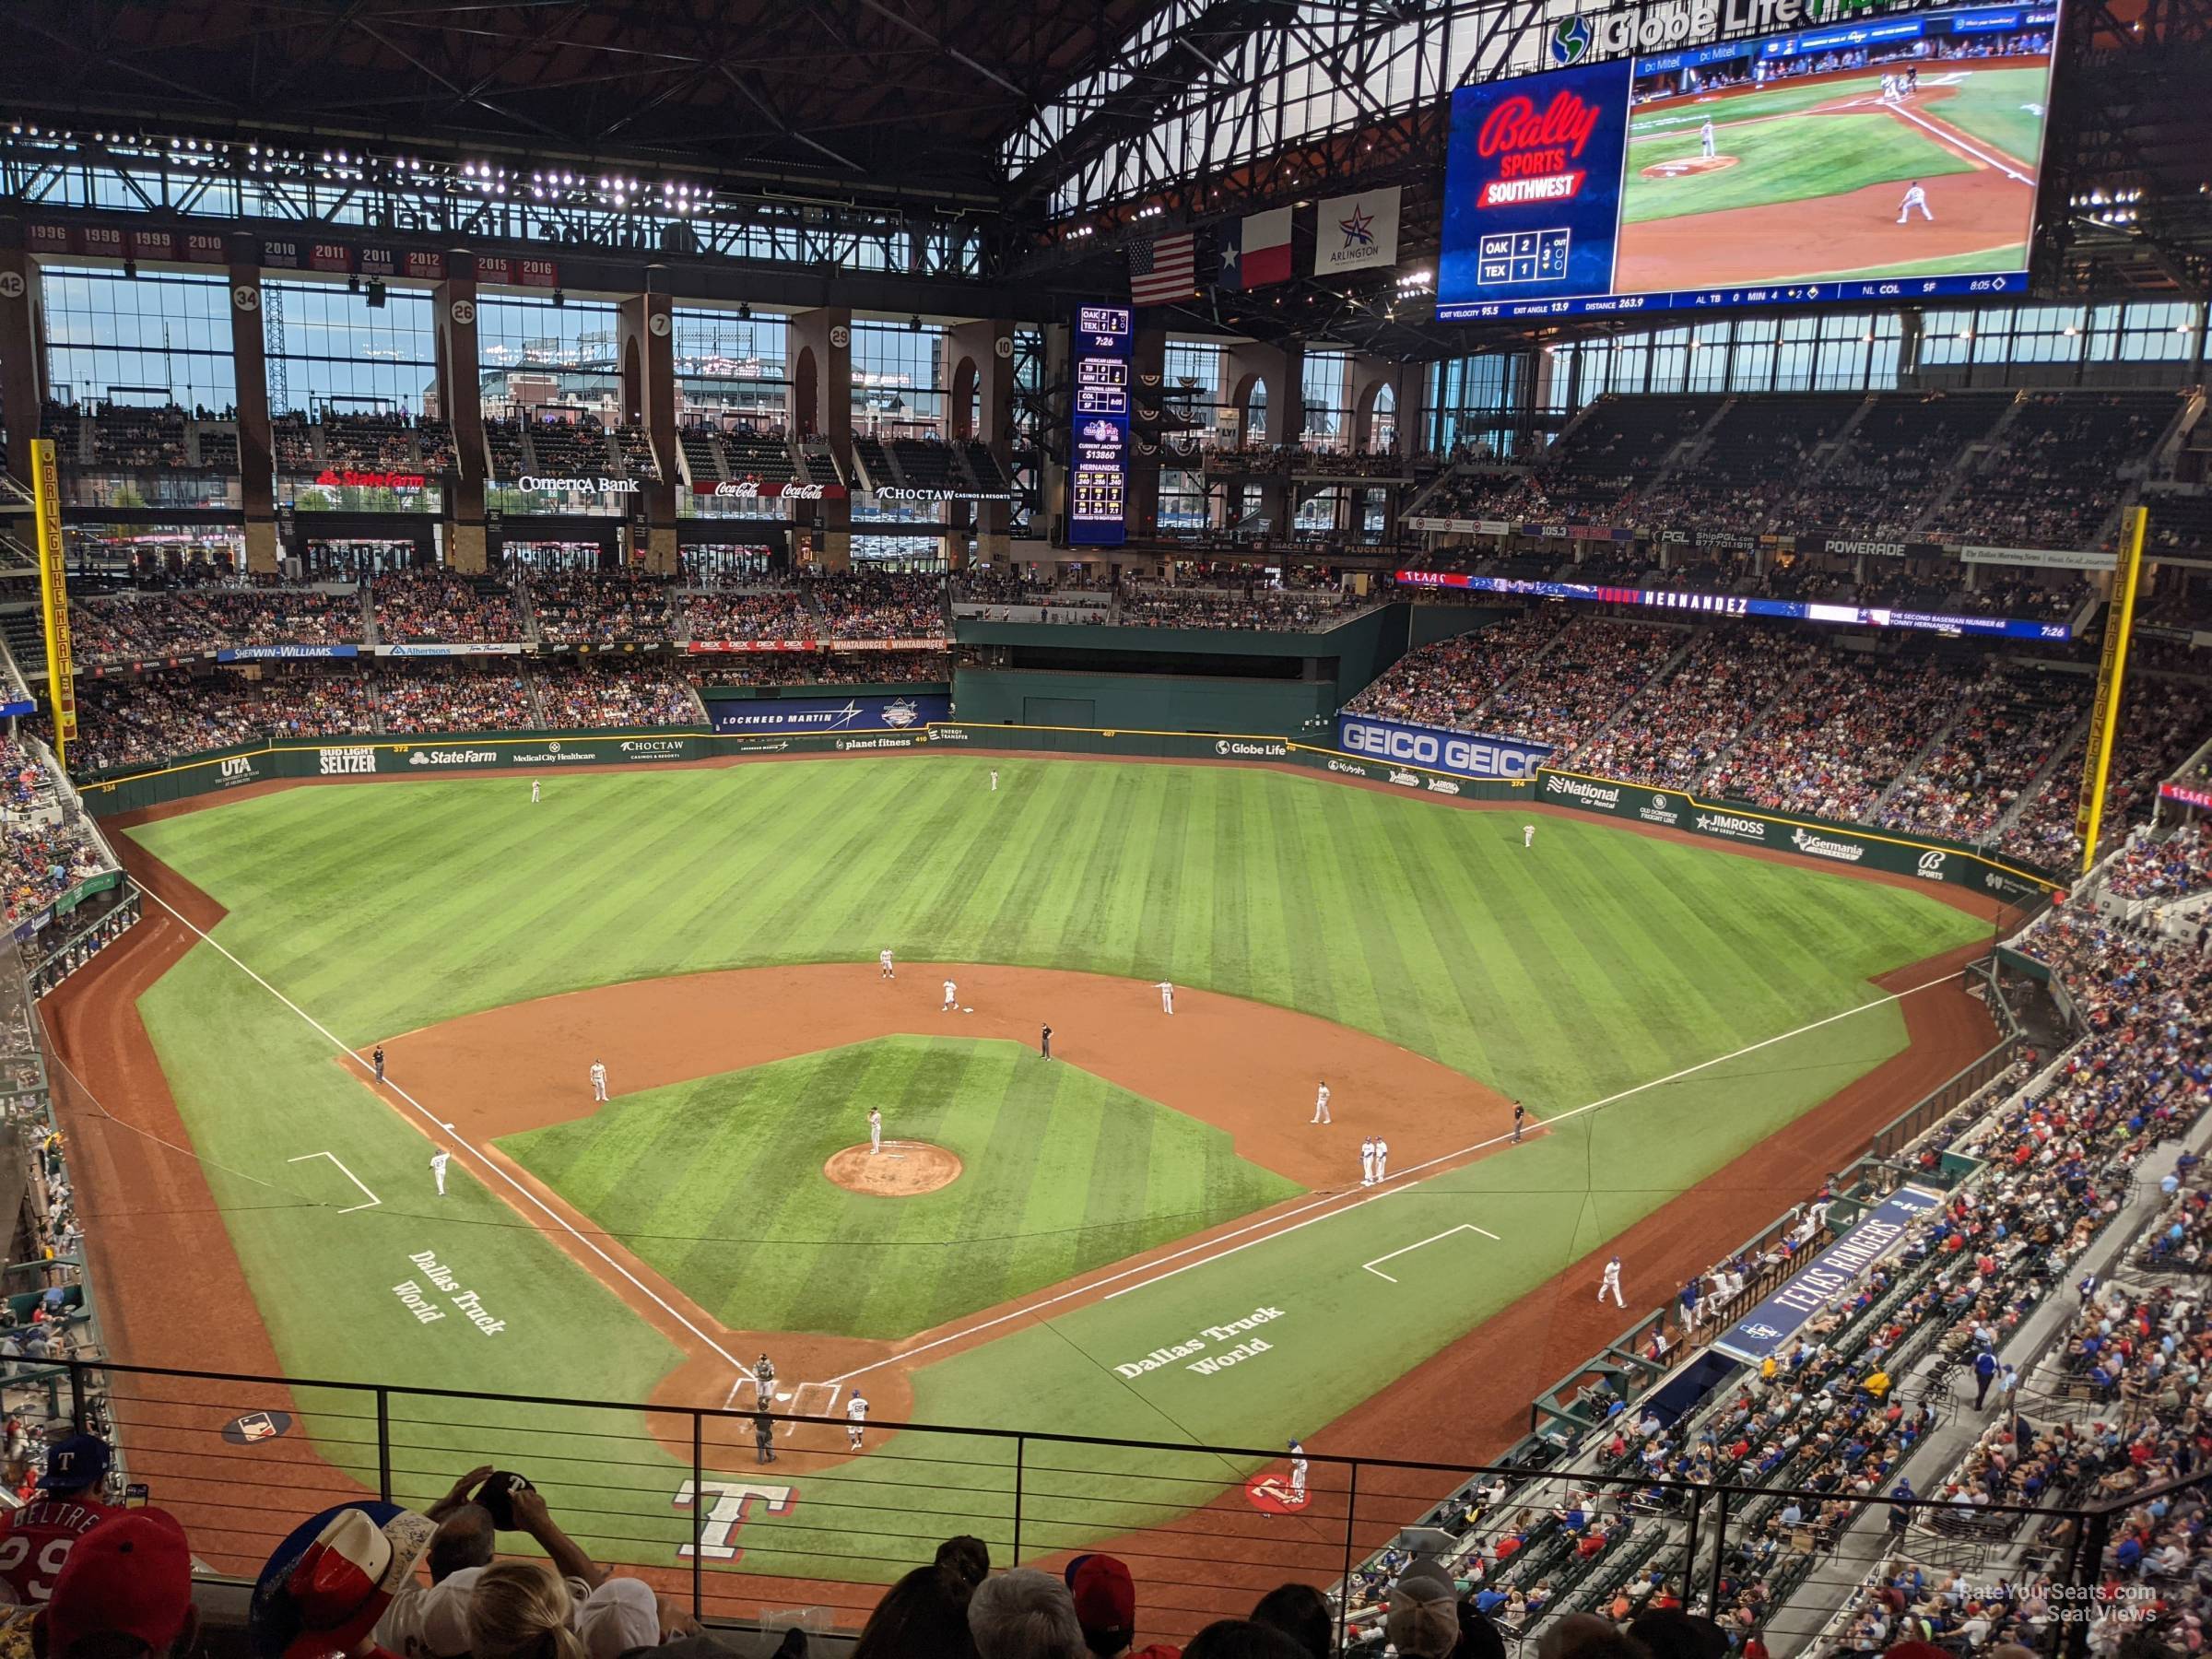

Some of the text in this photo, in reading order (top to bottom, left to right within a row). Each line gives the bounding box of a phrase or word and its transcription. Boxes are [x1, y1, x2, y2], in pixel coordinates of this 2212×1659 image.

[1600, 6, 1718, 53] Globe
[1477, 90, 1600, 158] Bally
[1500, 148, 1565, 178] SPORTS
[1488, 175, 1574, 204] SOUTHWEST
[31, 226, 66, 240] 1996
[85, 229, 121, 243] 1998
[135, 231, 171, 246] 1999
[189, 235, 221, 250] 2010
[265, 242, 296, 255] 2010
[1486, 240, 1529, 254] OAK 2
[1554, 239, 1566, 247] OUT
[315, 245, 345, 259] 2011
[363, 249, 391, 263] 2011
[1330, 245, 1379, 262] ARLINGTON
[1543, 249, 1550, 261] 3
[410, 253, 440, 266] 2012
[478, 257, 507, 271] 2015
[524, 261, 552, 275] 2016
[1485, 264, 1527, 277] TEX 1
[0, 278, 22, 292] 42
[1863, 279, 1990, 295] NL COL SF 8:05
[236, 290, 257, 306] 34
[1696, 289, 1802, 304] AL TB 0 MIN 4 2
[1527, 305, 1547, 313] ANGLE
[1551, 302, 1569, 312] 13.9
[1585, 298, 1643, 311] DISTANCE 263.9
[453, 305, 473, 320] 26
[1083, 311, 1106, 320] OAK 2
[1453, 310, 1479, 318] VELOCITY
[1481, 307, 1499, 316] 95.5
[653, 318, 667, 333] 7
[1084, 322, 1098, 330] TEX
[831, 329, 848, 344] 29
[1095, 336, 1113, 346] 7:26
[999, 341, 1010, 354] 10
[1086, 451, 1115, 459] $13860
[598, 478, 640, 492] Bank
[885, 487, 955, 501] CHOCTAW
[1541, 525, 1567, 536] 105.3
[1662, 531, 1689, 543] PGL
[1825, 540, 1905, 556] POWERADE
[1645, 591, 1747, 613] HERNANDEZ
[1889, 619, 1955, 629] YONNY HERNANDEZ
[1904, 613, 1930, 621] SECOND
[1932, 616, 1965, 625] BASEMAN
[1966, 618, 1994, 628] NUMBER
[2041, 627, 2065, 637] 7:26
[406, 646, 452, 656] Albertsons
[833, 640, 888, 650] WHATABURGER
[891, 640, 944, 649] WHATABURGER
[104, 665, 124, 674] TOYOTA
[142, 662, 160, 670] TOYOTA
[723, 713, 832, 725] LOCKHEED MARTIN
[394, 745, 409, 753] 372
[628, 741, 684, 751] CHOCTAW
[846, 736, 911, 750] planet fitness
[1231, 743, 1265, 754] Globe
[1266, 745, 1286, 755] Life
[1343, 724, 1439, 763] GEICO
[320, 747, 375, 757] BUD LIGHT
[513, 752, 595, 762] Medical City Healthcare
[221, 757, 251, 777] UTA
[320, 755, 376, 775] SELTZER
[1340, 762, 1365, 775] Kubota
[1562, 779, 1619, 802] National
[1580, 797, 1616, 809] Car Rental
[1641, 812, 1676, 824] FREIGHT LINE
[1651, 808, 1678, 818] DOMINION
[1811, 837, 1863, 856] Germania
[1917, 868, 1944, 880] SPORTS
[1773, 1218, 1902, 1312] TEXAS RANGERS
[408, 1250, 507, 1336] Dallas Truck
[392, 1279, 447, 1324] World
[1113, 1305, 1286, 1380] Dallas Truck
[1185, 1337, 1274, 1375] World
[58, 1452, 75, 1471] T
[13, 1502, 100, 1534] BELTRE
[672, 1478, 800, 1564] T
